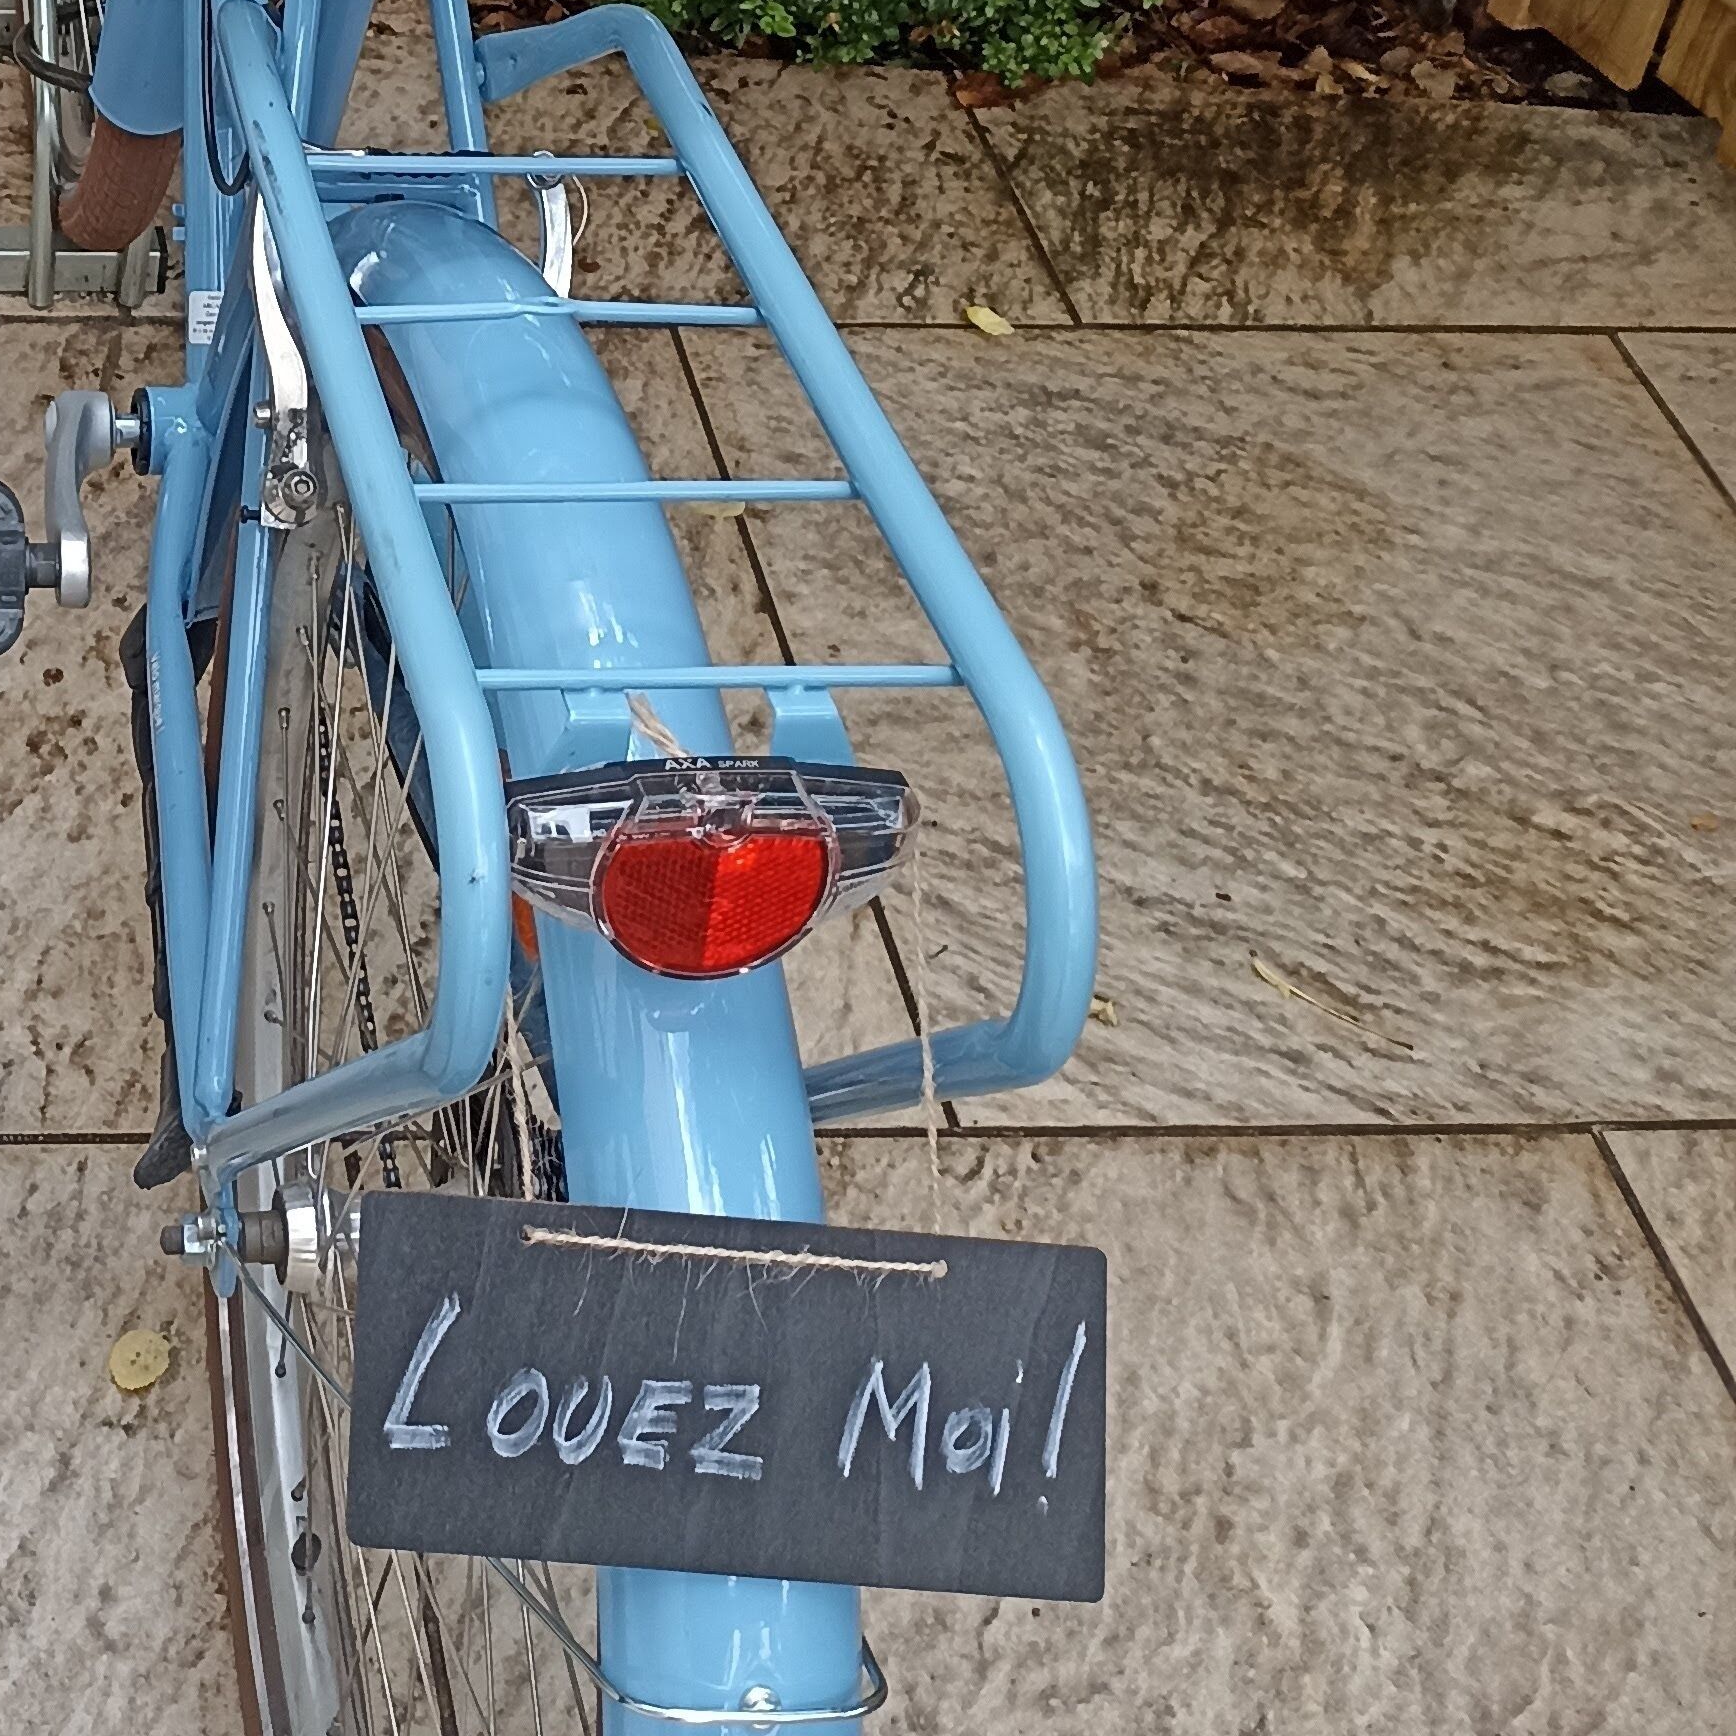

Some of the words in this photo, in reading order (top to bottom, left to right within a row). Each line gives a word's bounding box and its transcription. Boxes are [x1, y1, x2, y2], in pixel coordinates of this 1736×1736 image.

[664, 758, 712, 771] AXA
[717, 759, 759, 769] SPARK
[382, 1291, 765, 1480] LOUEZ
[836, 1320, 1088, 1515] Moi!
